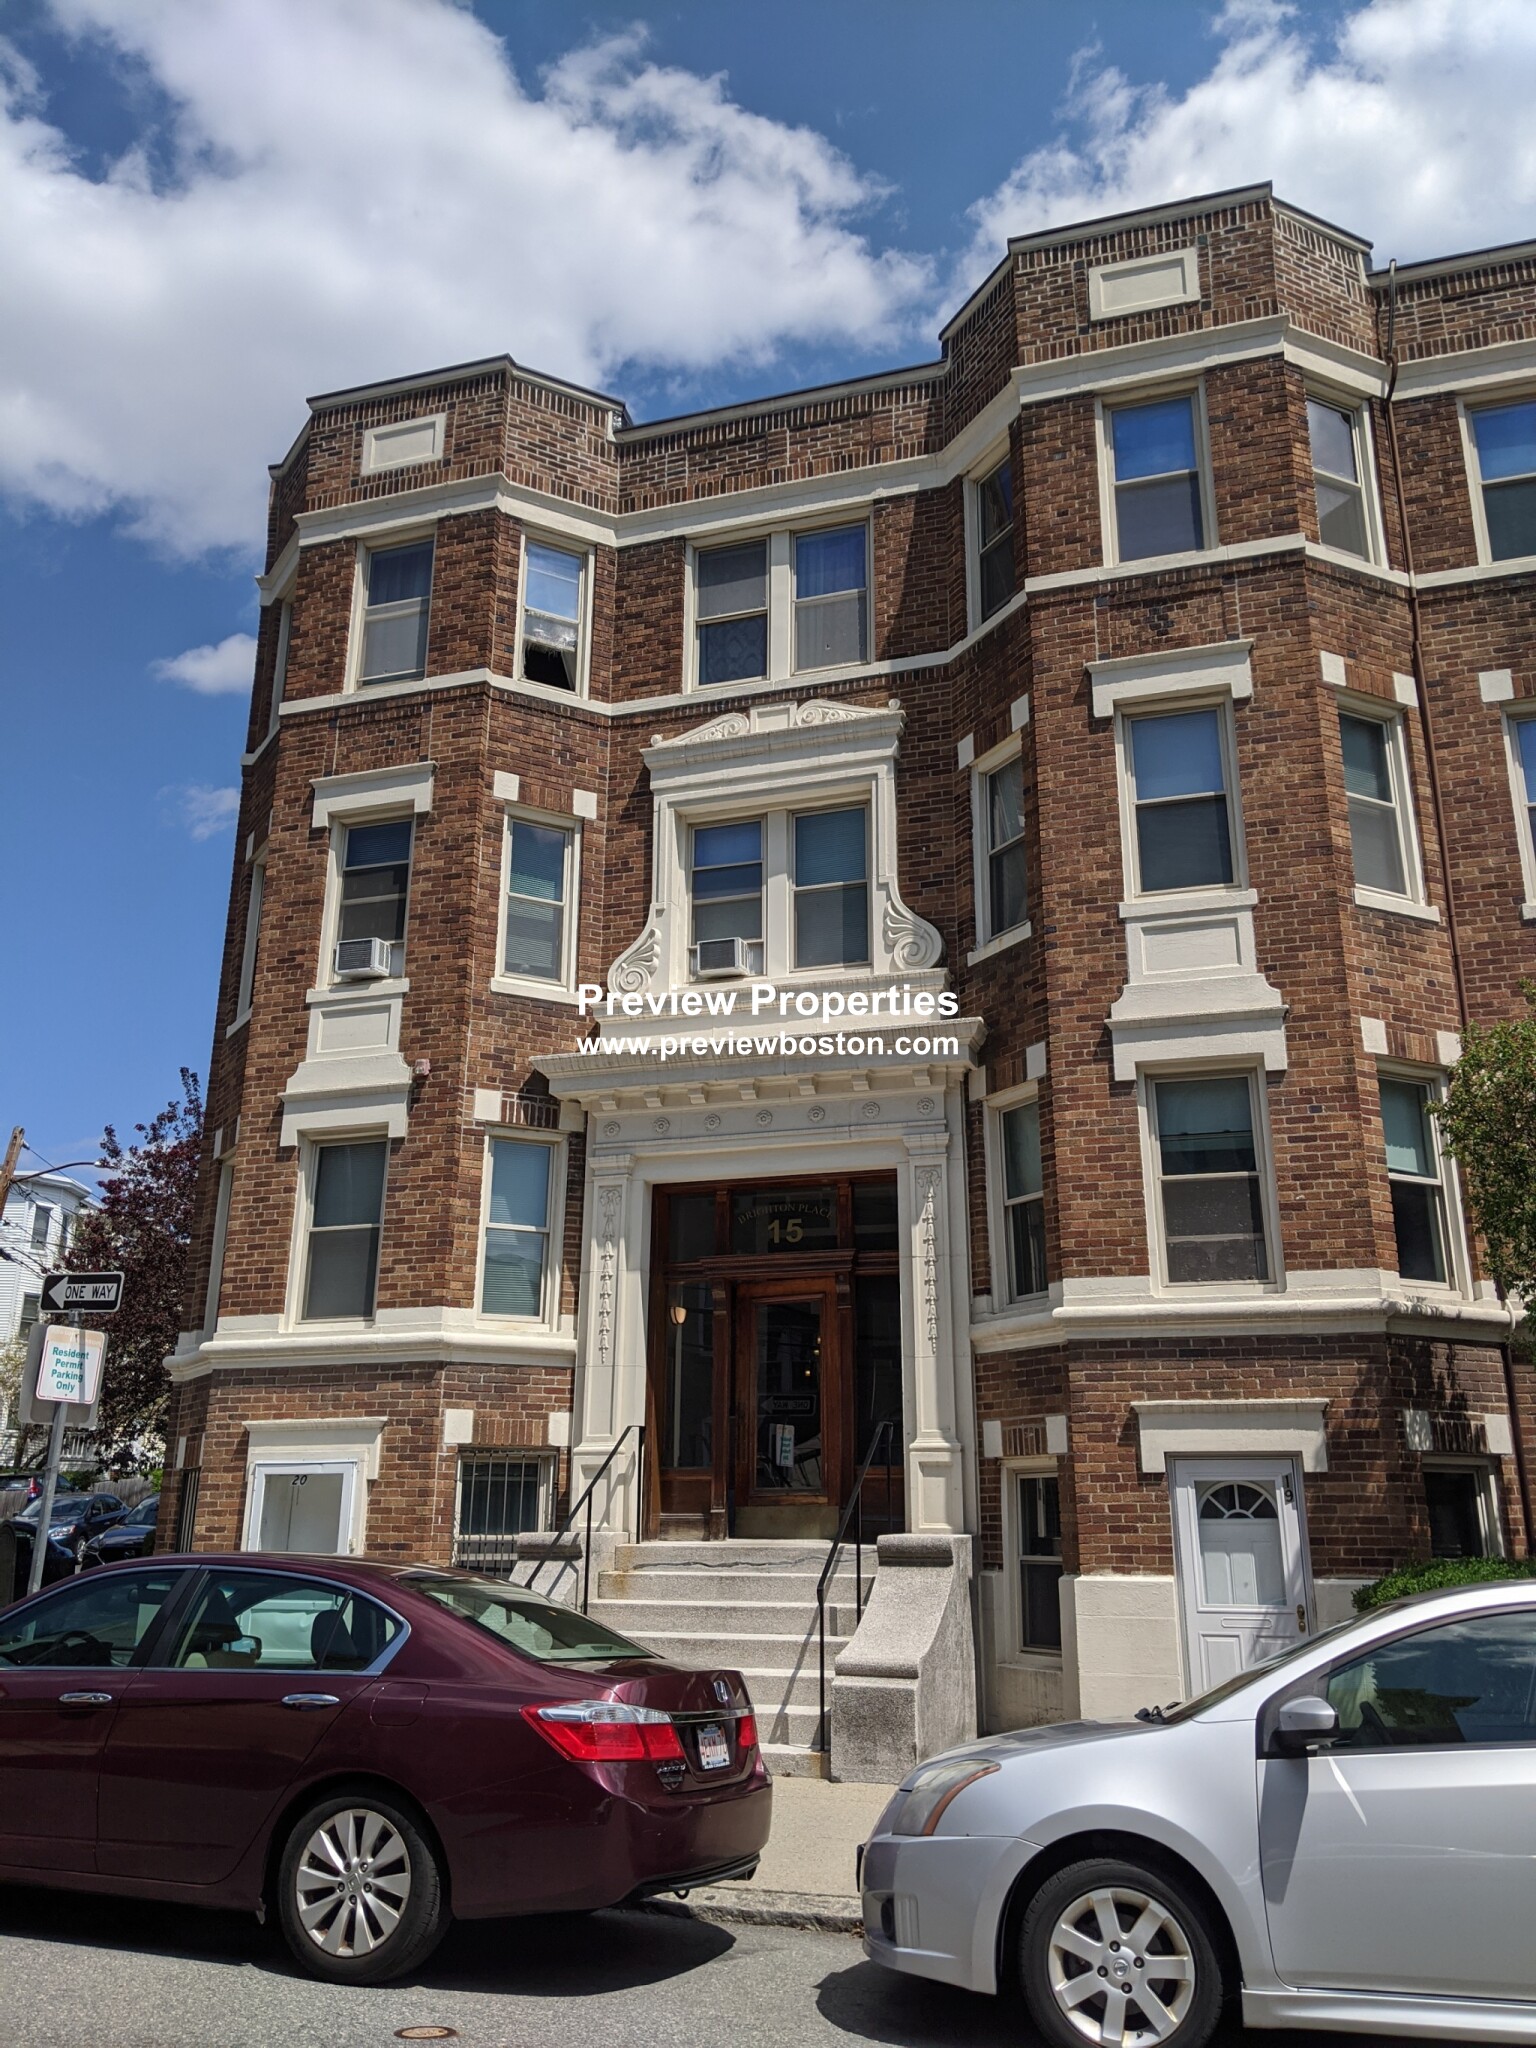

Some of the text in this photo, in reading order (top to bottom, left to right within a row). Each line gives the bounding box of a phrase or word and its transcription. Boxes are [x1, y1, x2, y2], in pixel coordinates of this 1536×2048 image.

[737, 1203, 833, 1224] BRIGHTON PLACE
[767, 1218, 804, 1244] 15
[65, 1285, 114, 1299] ONE WAY
[52, 1347, 89, 1360] Resident
[55, 1358, 83, 1370] Permit
[51, 1369, 83, 1382] Parking
[56, 1381, 75, 1393] Only
[292, 1474, 308, 1486] 20
[1285, 1475, 1294, 1502] 19
